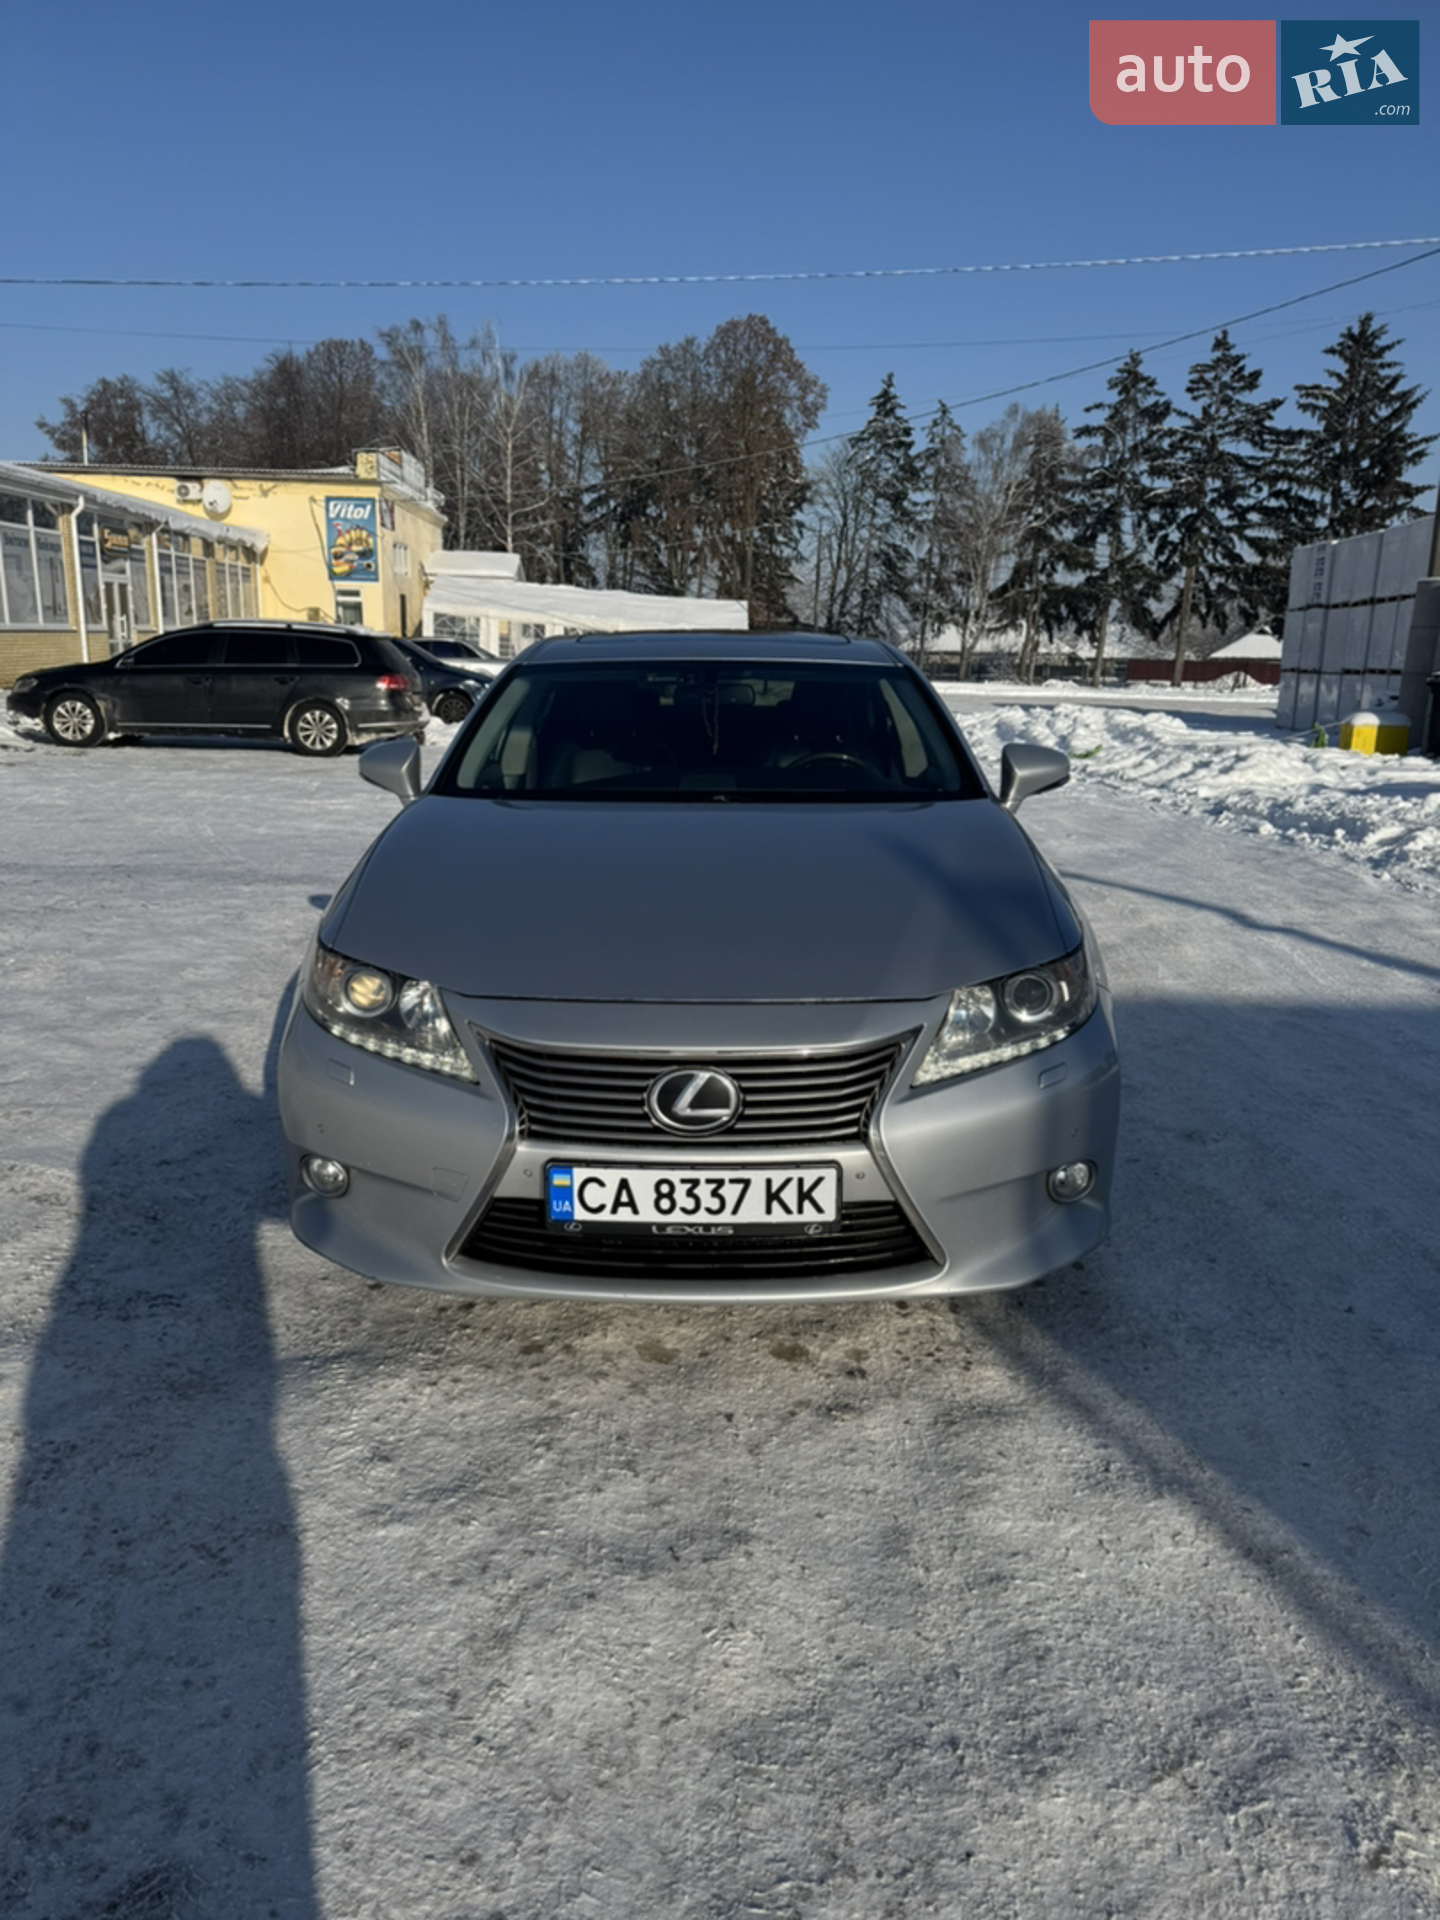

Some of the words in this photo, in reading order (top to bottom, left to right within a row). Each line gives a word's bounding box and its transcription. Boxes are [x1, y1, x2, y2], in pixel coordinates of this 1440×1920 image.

[329, 501, 371, 519] Vitol
[577, 1176, 640, 1215] CA
[653, 1177, 752, 1216] 8337
[765, 1176, 826, 1215] KK
[552, 1200, 572, 1212] UA
[652, 1225, 734, 1236] LEXUS
